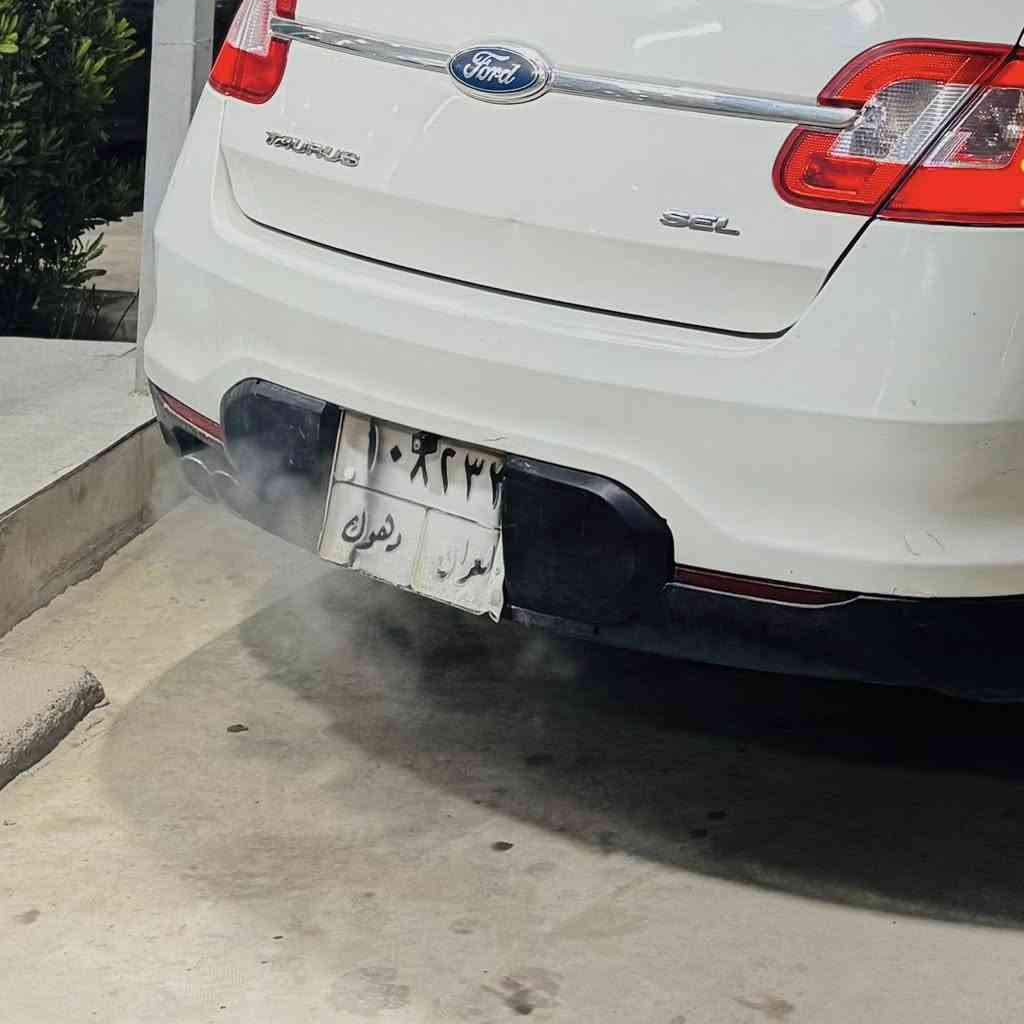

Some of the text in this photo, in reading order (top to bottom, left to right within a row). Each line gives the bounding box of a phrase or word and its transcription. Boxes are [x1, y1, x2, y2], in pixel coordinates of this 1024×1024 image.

[463, 50, 521, 85] Ford
[264, 130, 361, 168] TAURUS
[659, 208, 741, 236] SEL
